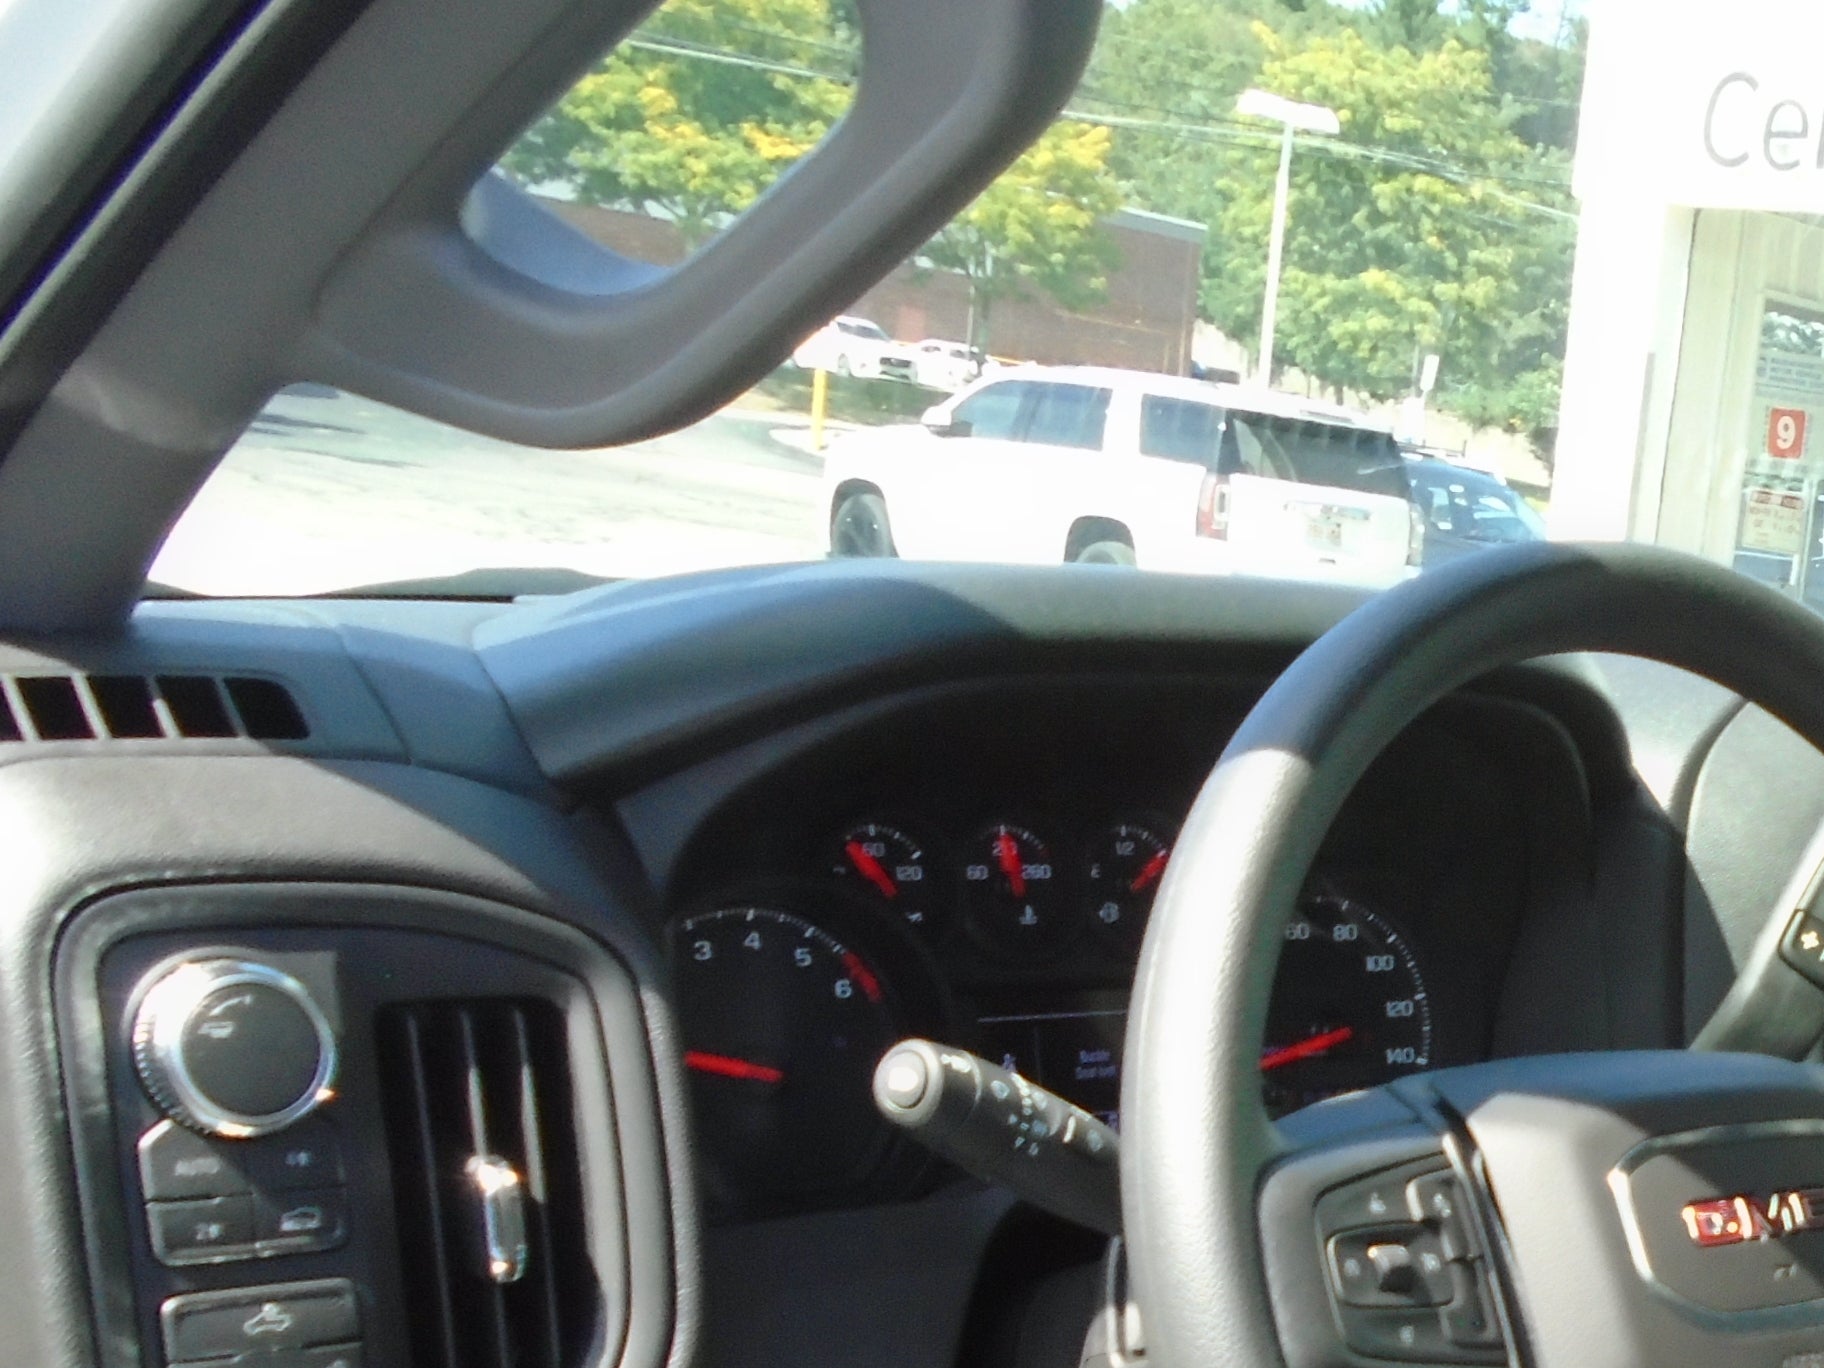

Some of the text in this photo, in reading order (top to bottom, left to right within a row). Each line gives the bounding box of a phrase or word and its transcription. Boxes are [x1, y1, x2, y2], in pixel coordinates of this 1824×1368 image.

[1775, 414, 1797, 451] 9
[743, 931, 762, 950] 4
[1332, 923, 1358, 942] 80
[694, 940, 713, 961] 3
[794, 948, 813, 967] 5
[1364, 954, 1395, 972] 100
[834, 977, 852, 999] 6
[1385, 1000, 1415, 1018] 120
[1385, 1046, 1416, 1065] 140
